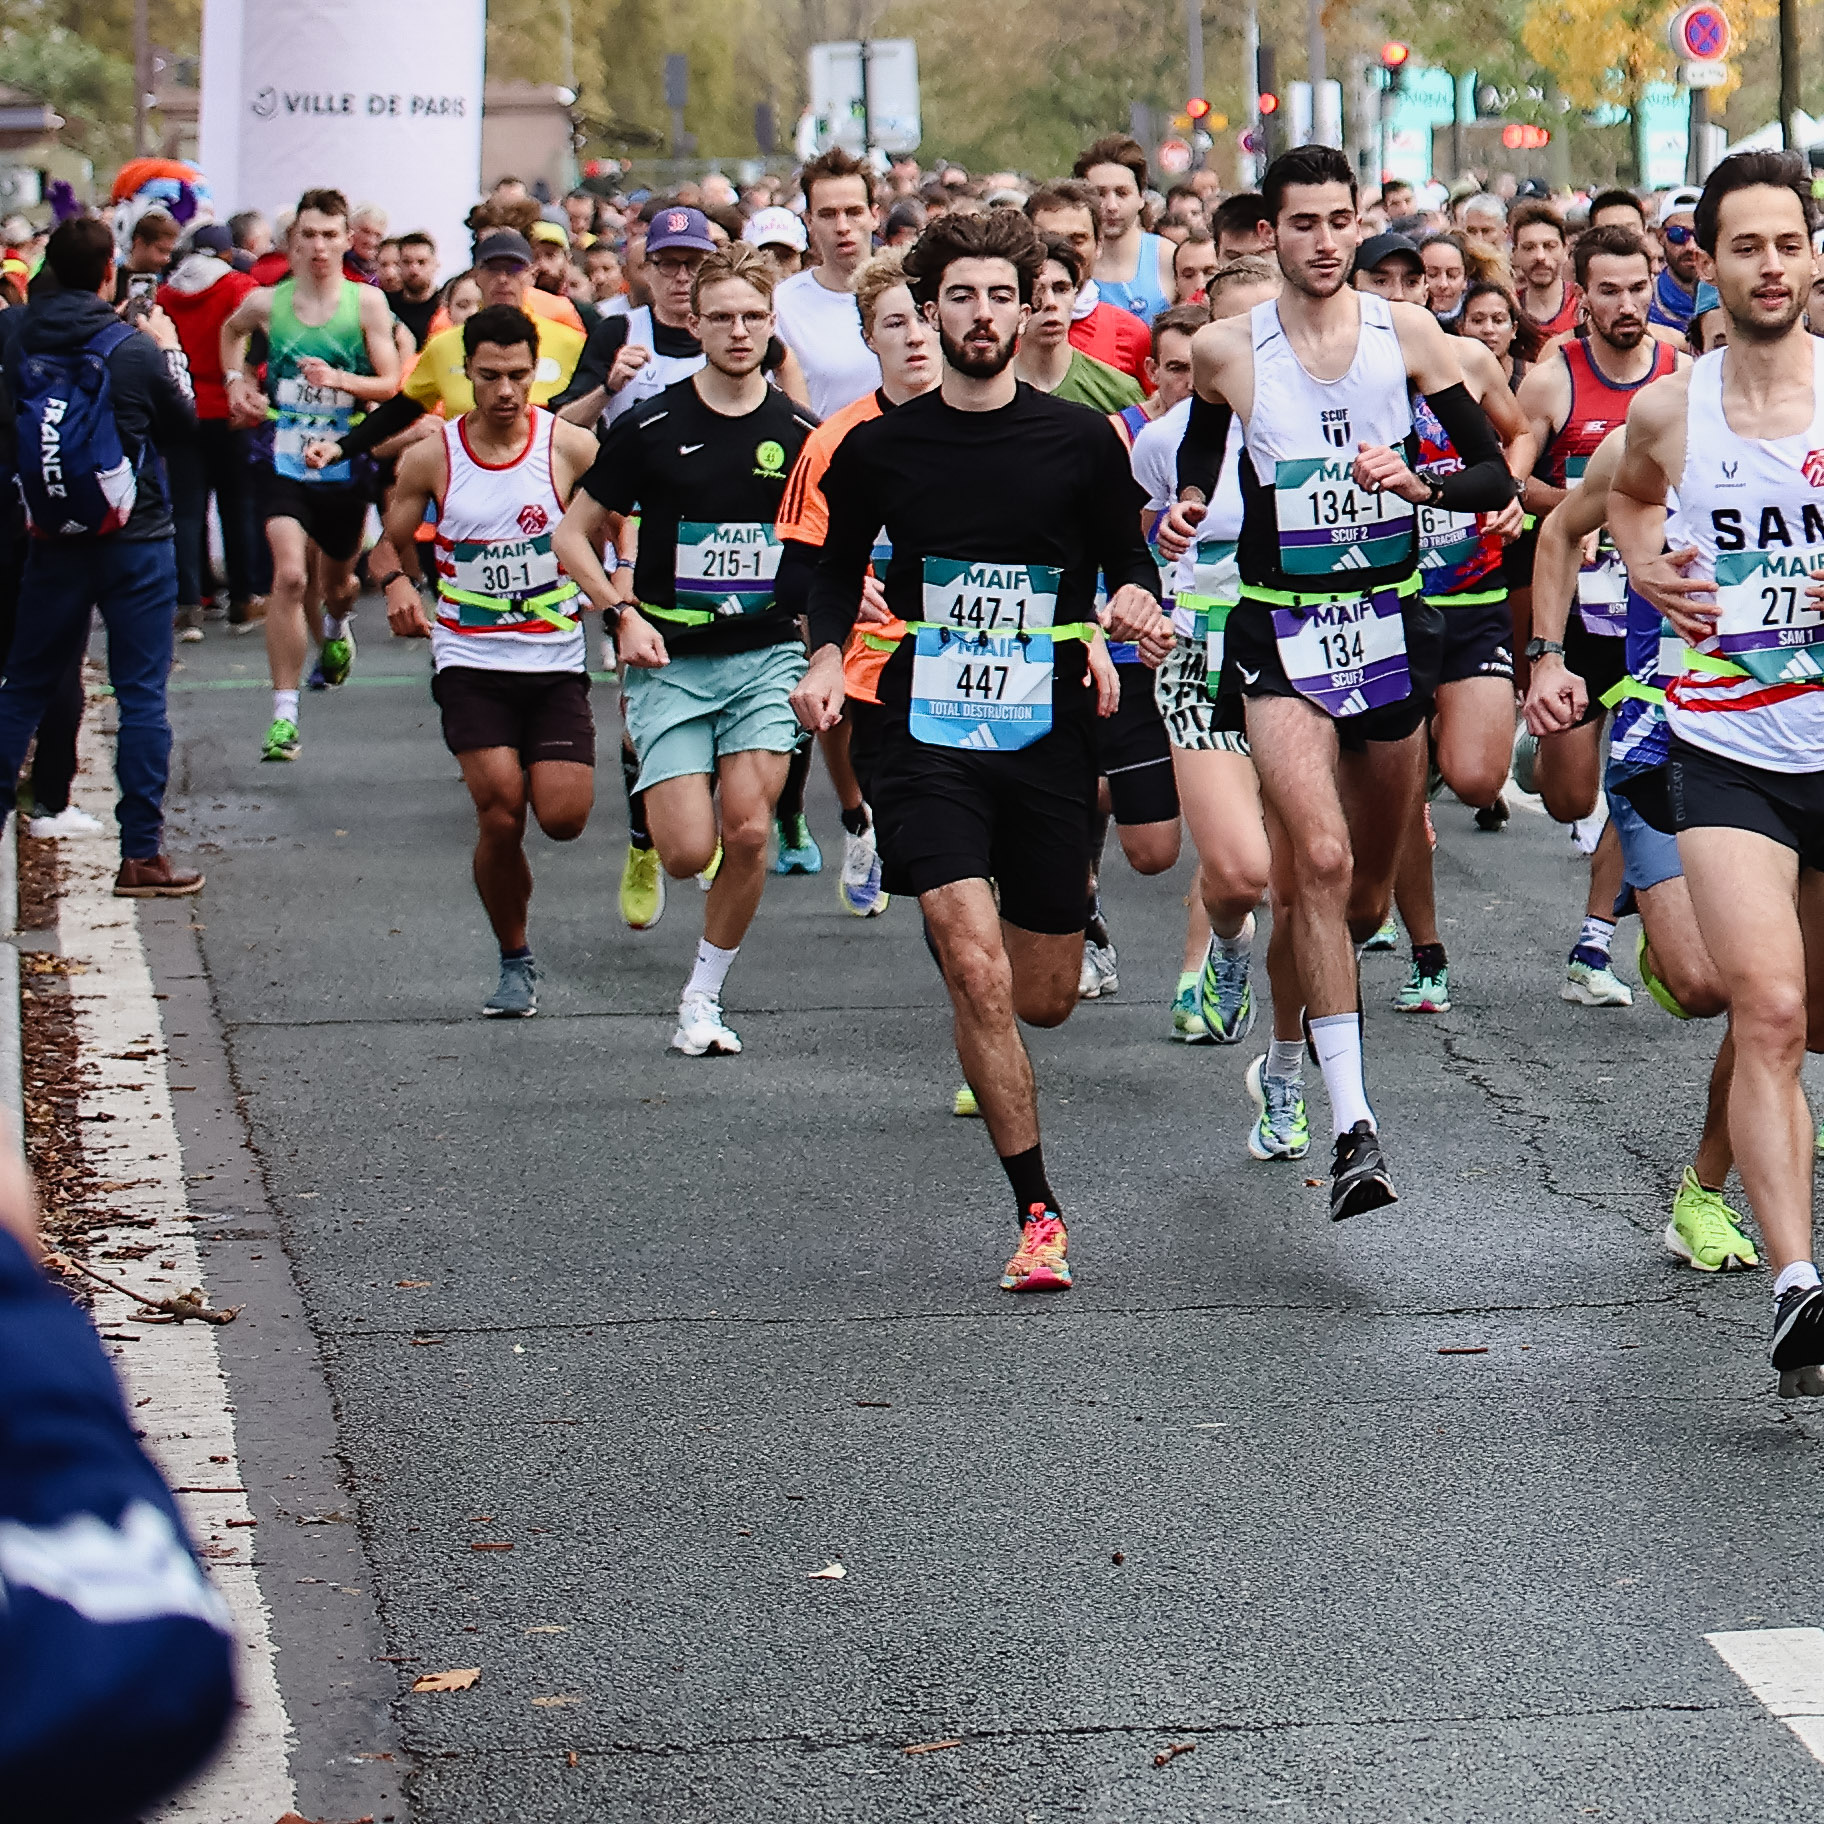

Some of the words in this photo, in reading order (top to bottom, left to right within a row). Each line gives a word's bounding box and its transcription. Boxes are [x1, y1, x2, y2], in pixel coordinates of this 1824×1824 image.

[285, 91, 355, 117] VILLE
[369, 92, 401, 116] DE
[411, 93, 466, 118] PARIS
[1321, 408, 1350, 423] SCUF
[40, 397, 69, 498] FRANCE
[714, 528, 763, 543] MAIF
[1331, 528, 1359, 544] SCUF
[1361, 526, 1369, 539] 2
[1430, 529, 1468, 547] TRACTEUR
[483, 542, 535, 559] MAIF
[703, 549, 762, 577] 215-1
[482, 563, 531, 591] 30-1
[963, 569, 1029, 590] MAIF
[950, 594, 1026, 630] 447-1
[1314, 599, 1373, 628] MAIF
[957, 634, 1022, 658] MAIF
[1778, 629, 1805, 646] SAM
[1809, 628, 1815, 643] 1
[1319, 629, 1365, 670] 134
[956, 664, 1009, 700] 447
[929, 700, 961, 716] TOTAL
[963, 702, 1033, 720] DESTRUCTION
